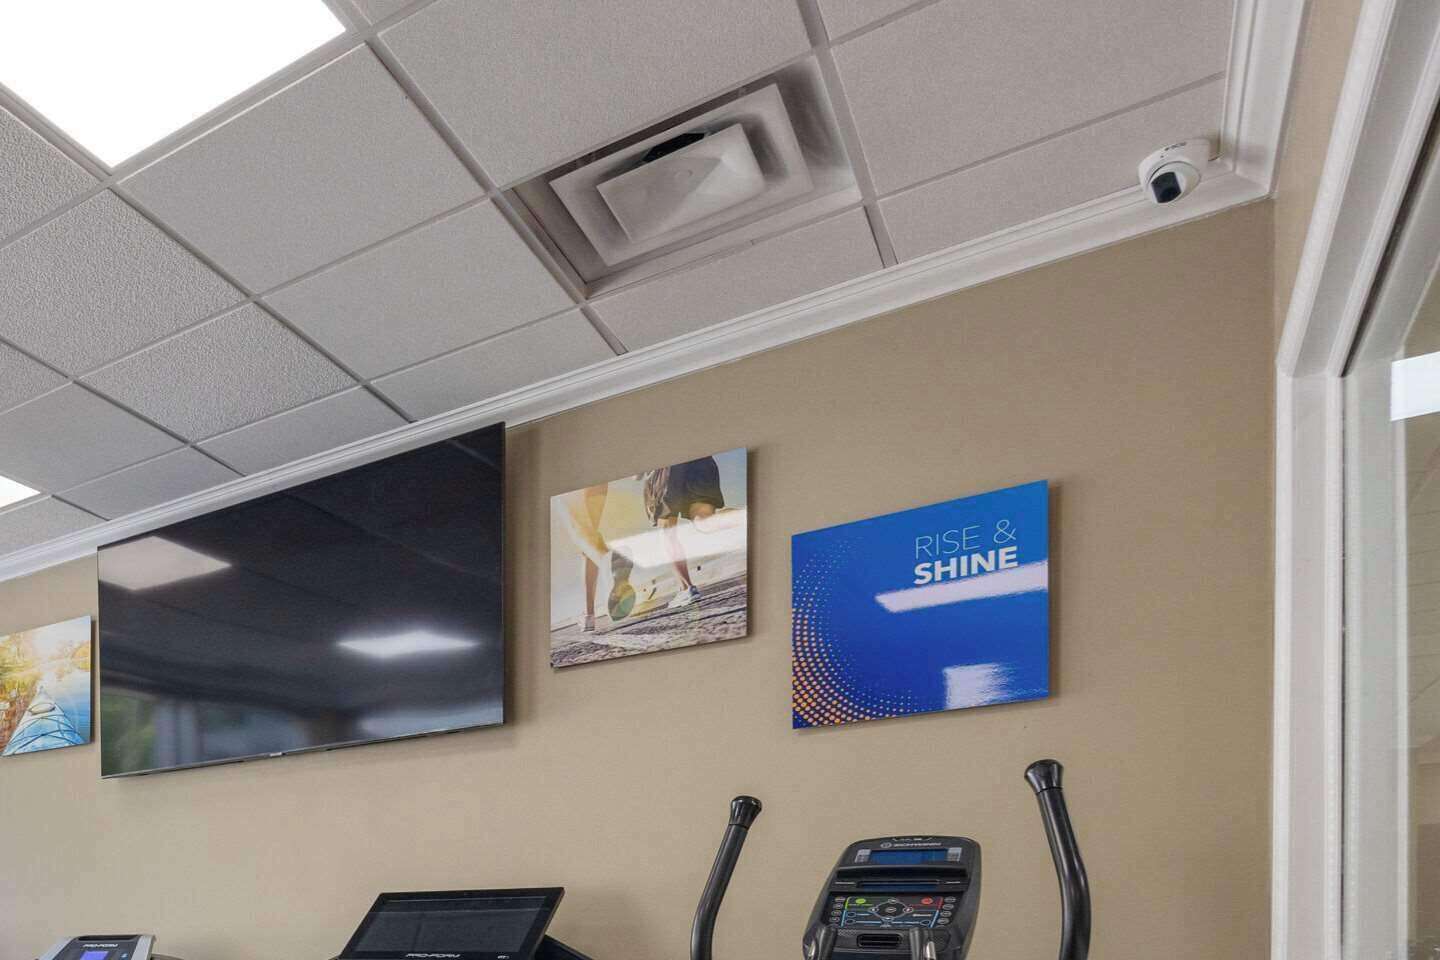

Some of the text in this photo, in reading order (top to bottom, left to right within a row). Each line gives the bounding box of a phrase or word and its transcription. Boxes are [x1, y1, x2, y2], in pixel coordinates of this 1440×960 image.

[915, 519, 1017, 560] RISE &
[913, 546, 1018, 585] SHINE
